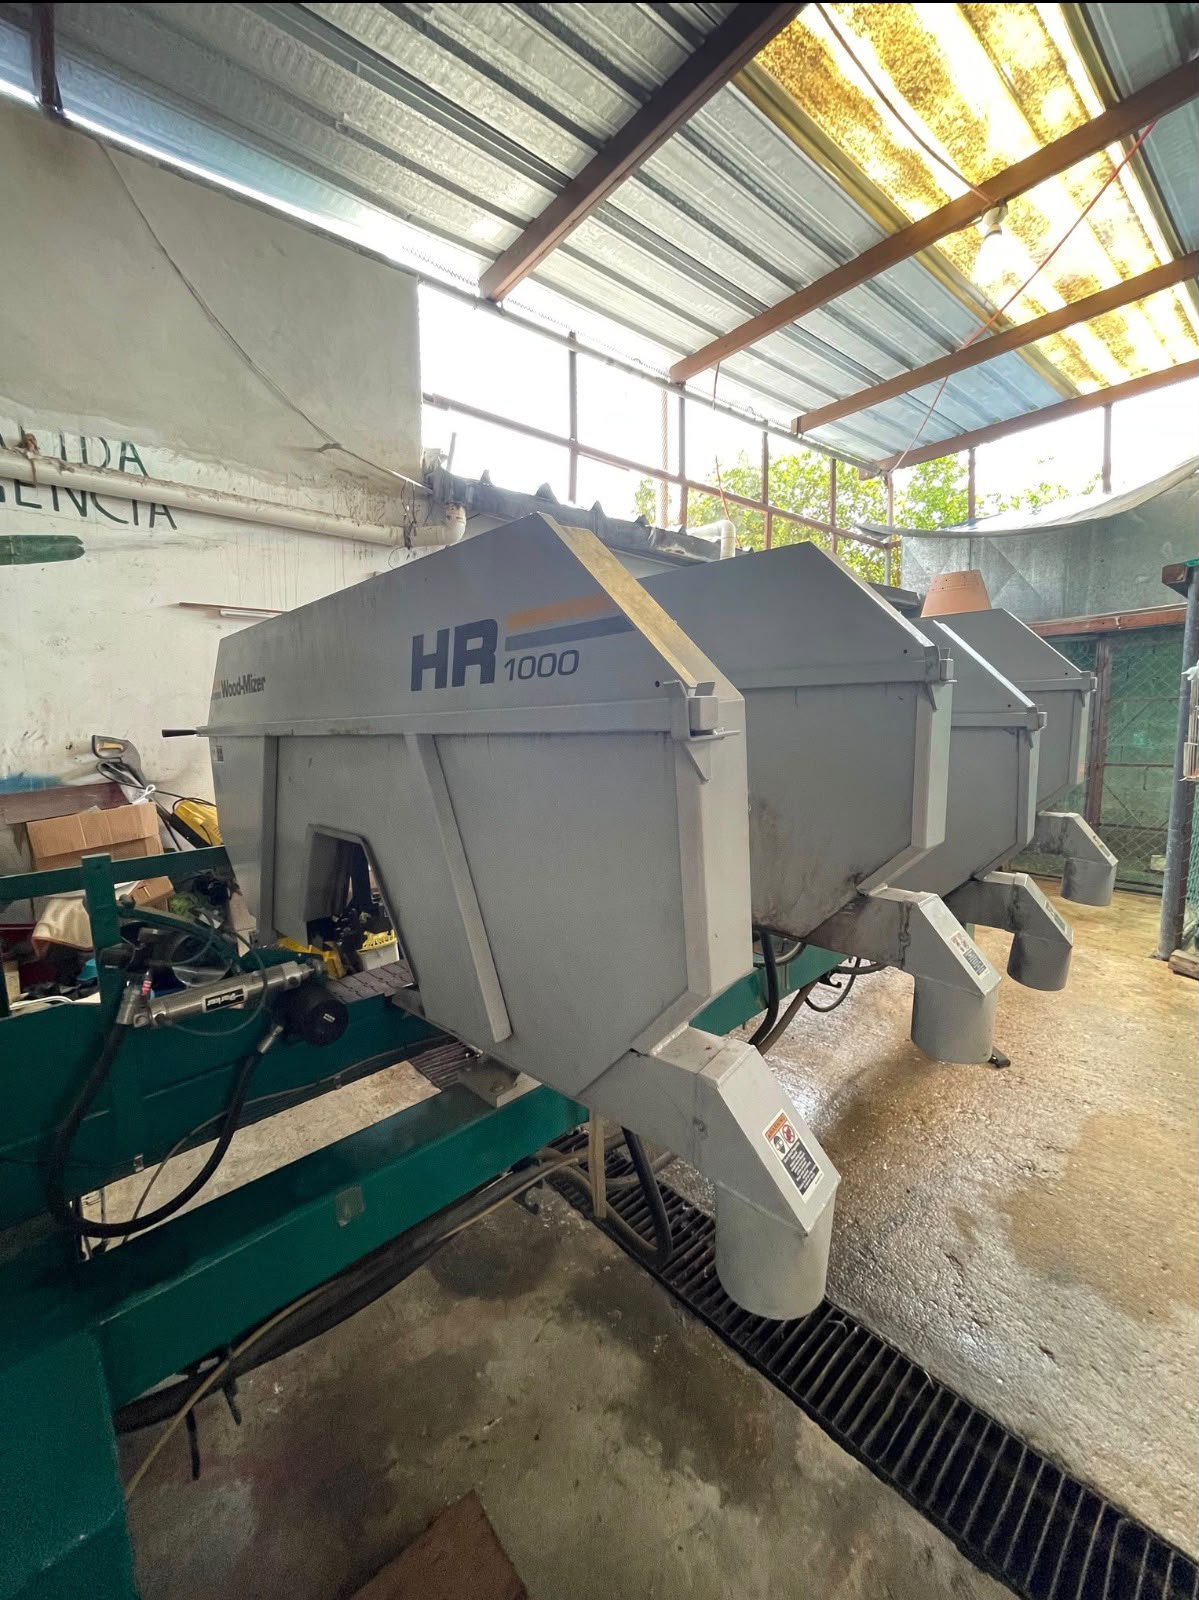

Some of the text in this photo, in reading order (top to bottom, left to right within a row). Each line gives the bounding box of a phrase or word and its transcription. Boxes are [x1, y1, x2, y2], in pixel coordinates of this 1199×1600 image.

[0, 479, 177, 529] ENCIA
[411, 618, 498, 691] HR
[504, 650, 579, 681] 1000
[220, 673, 266, 698] Wood-Mizer
